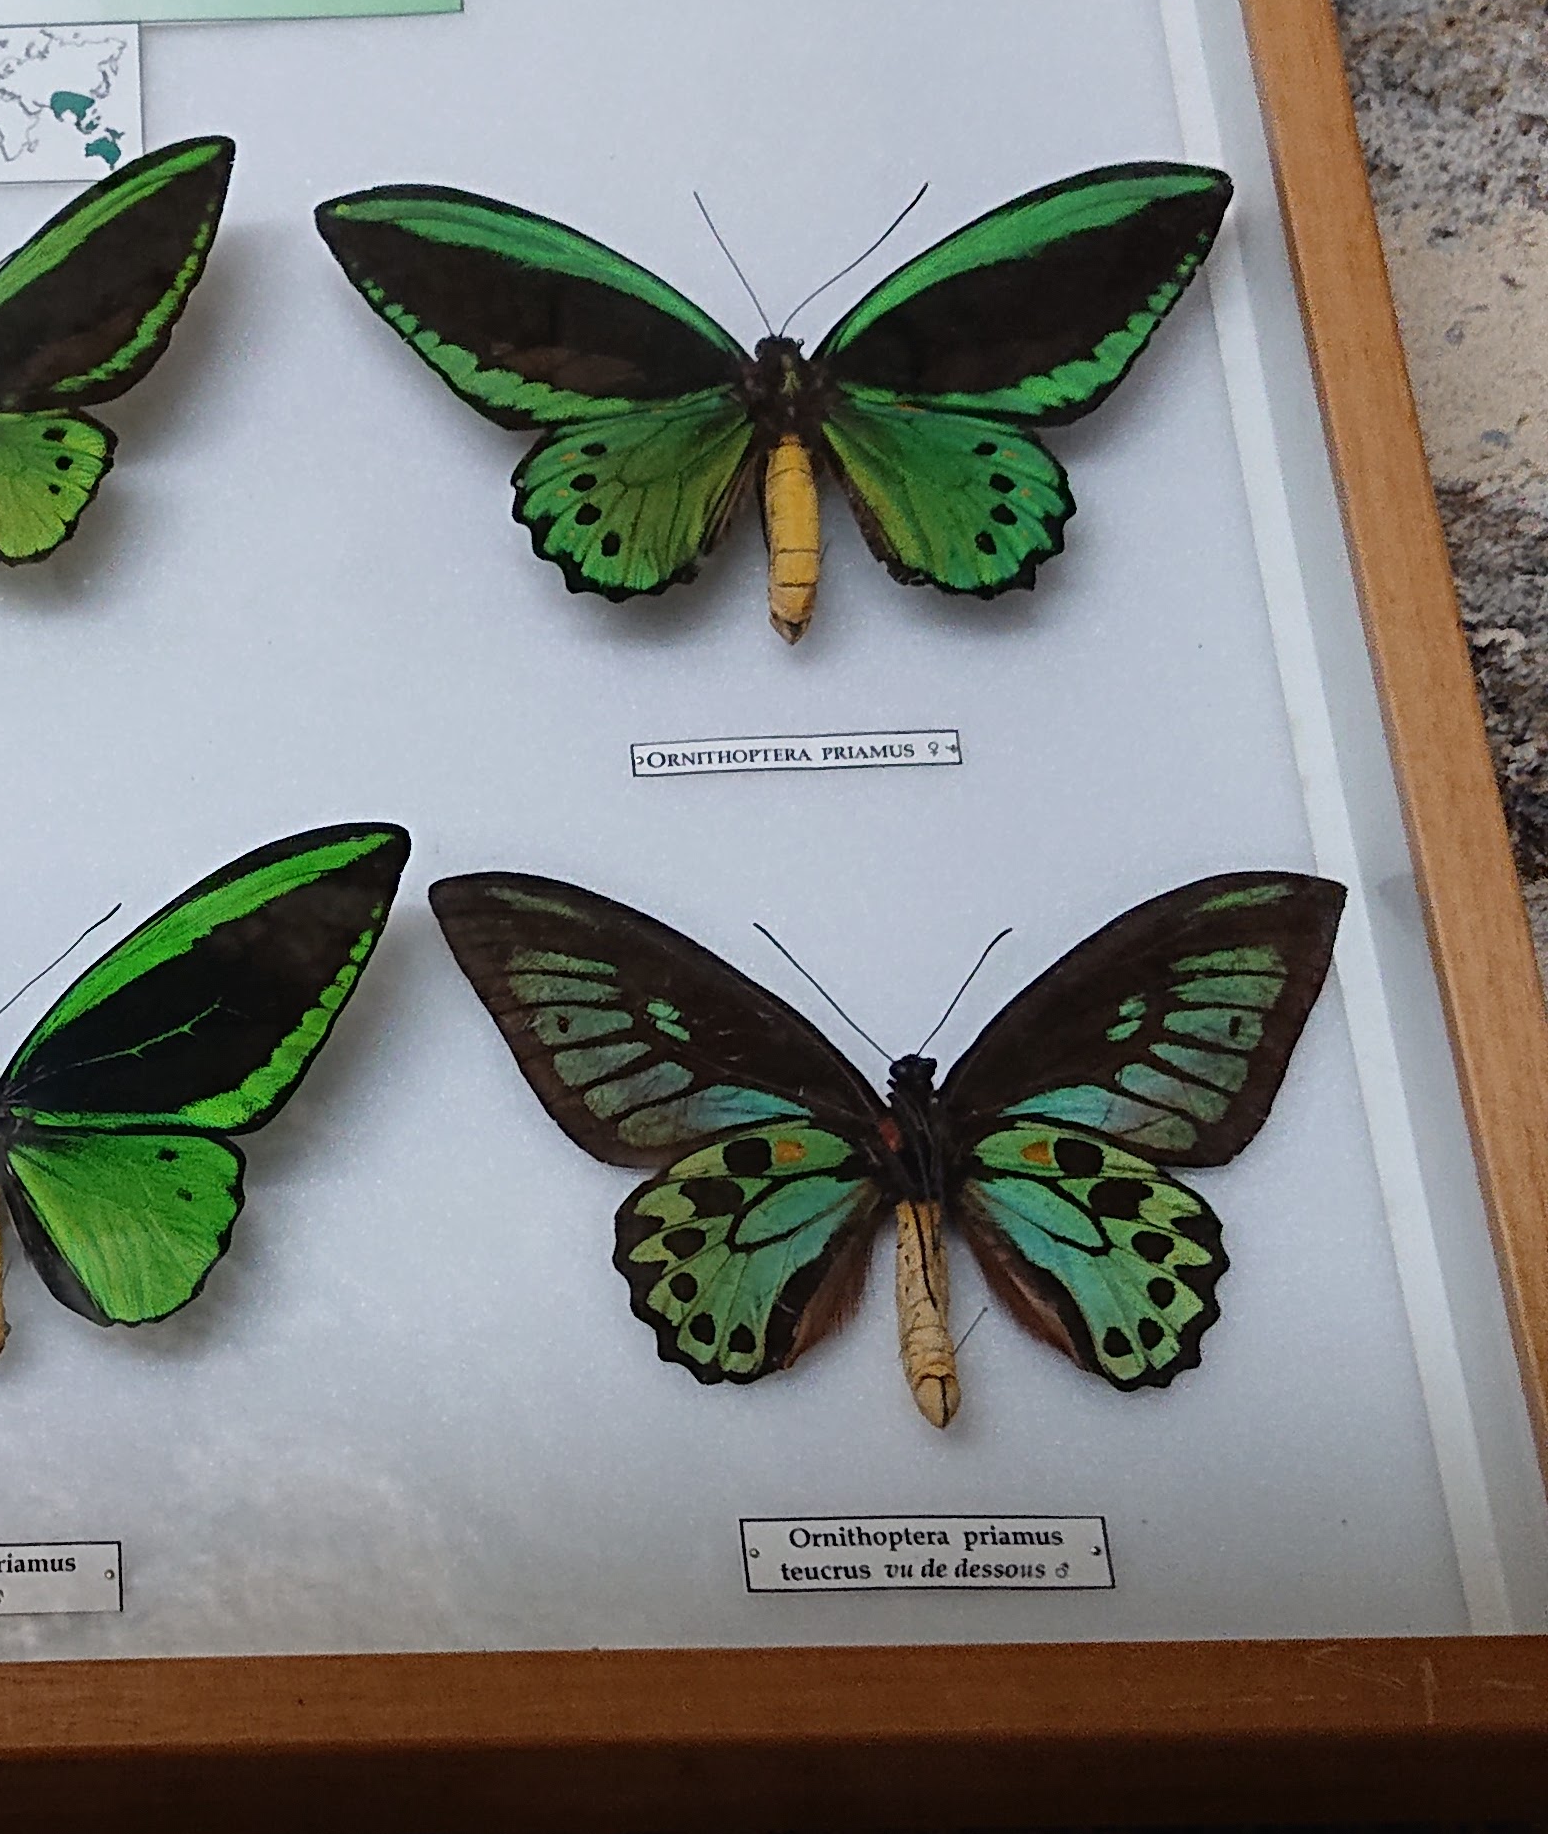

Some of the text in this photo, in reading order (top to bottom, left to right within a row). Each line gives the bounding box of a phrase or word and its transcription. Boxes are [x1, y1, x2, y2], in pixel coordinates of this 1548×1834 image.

[646, 744, 915, 768] ORNITHOPTERA PRIAMUS
[788, 1525, 1064, 1552] Ornithoptera priamus
[781, 1558, 1047, 1582] teucrus vu de dessous
